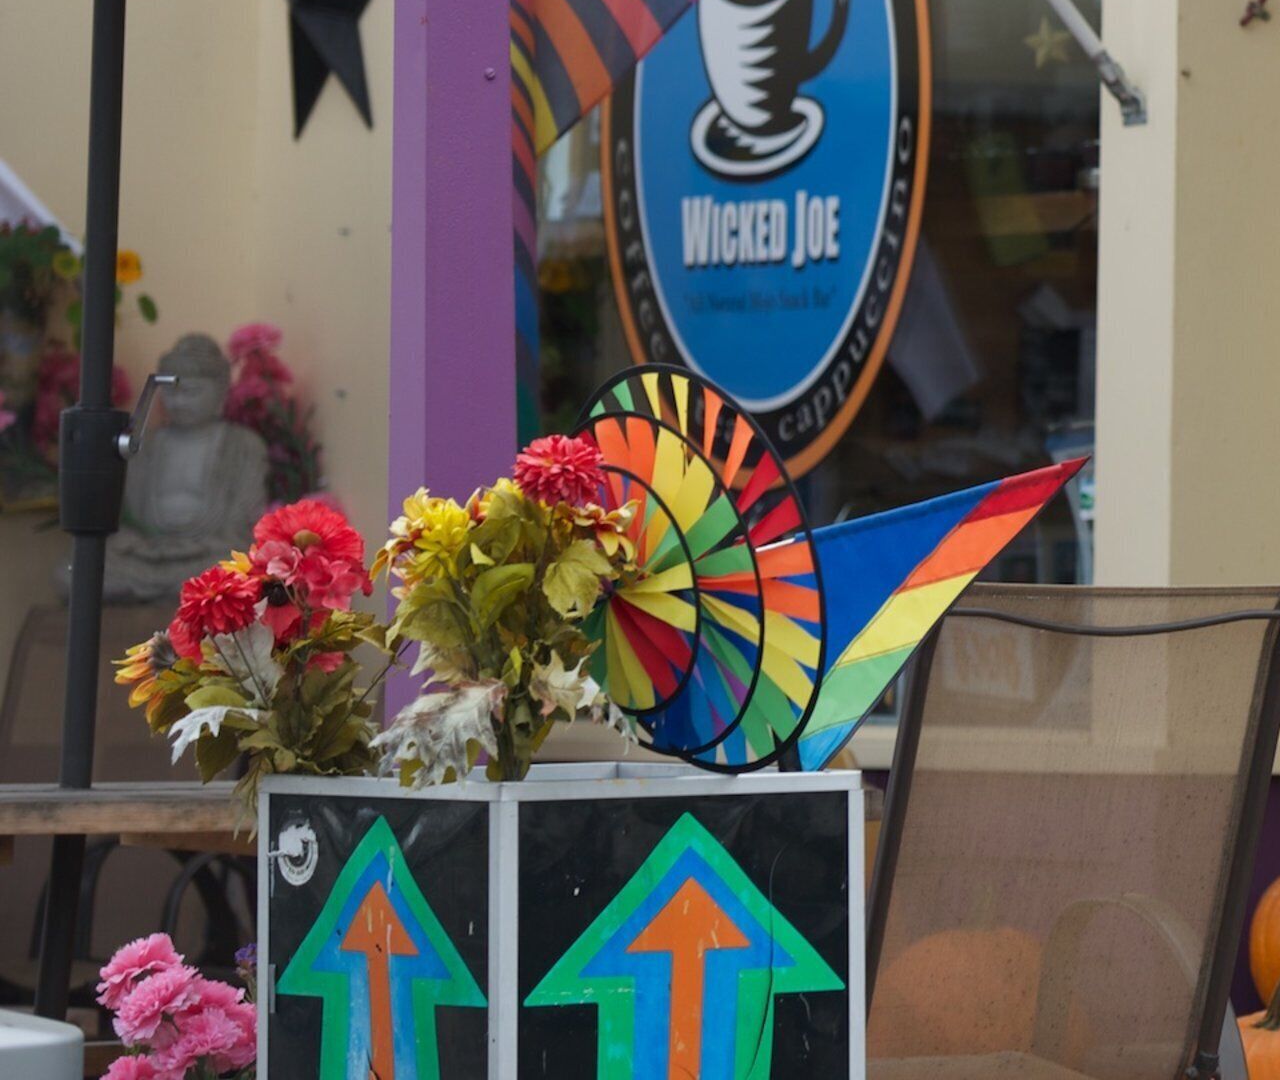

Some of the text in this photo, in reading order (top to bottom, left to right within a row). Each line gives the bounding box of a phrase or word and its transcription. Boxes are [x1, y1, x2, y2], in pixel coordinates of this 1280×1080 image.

[682, 190, 841, 268] WICKED JOE
[778, 116, 914, 443] cappuccino
